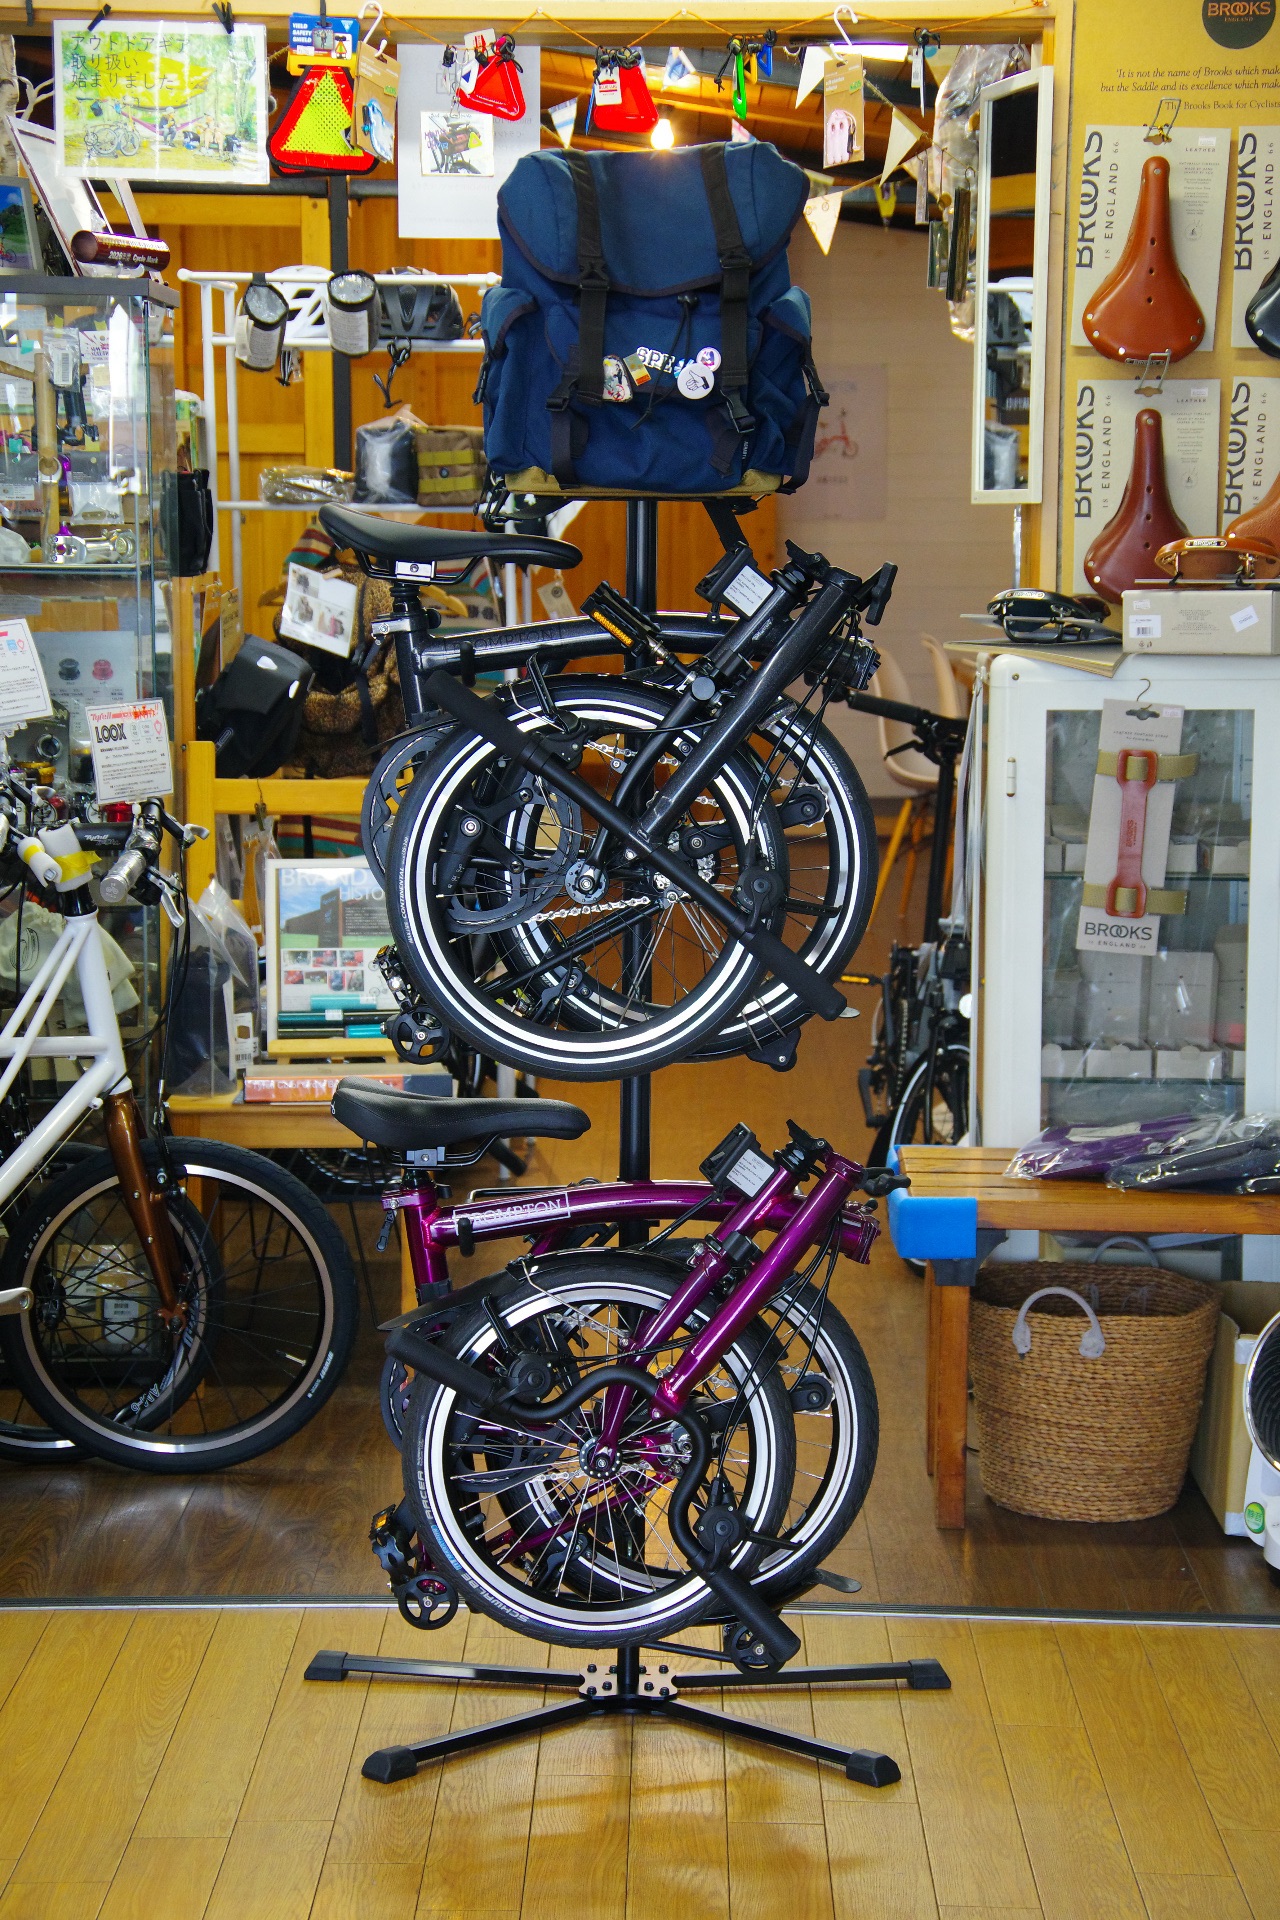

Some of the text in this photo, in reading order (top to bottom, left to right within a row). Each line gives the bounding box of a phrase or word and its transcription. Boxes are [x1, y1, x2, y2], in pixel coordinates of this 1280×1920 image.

[1207, 1, 1271, 16] BROOKS
[71, 35, 190, 53] アウトドアギア
[71, 53, 139, 71] 取り扱い
[1127, 69, 1134, 78] is
[1152, 68, 1165, 77] the
[1192, 67, 1202, 78] of
[1203, 66, 1233, 76] Brooks
[1235, 66, 1259, 76] which
[1261, 65, 1280, 75] mak
[71, 72, 175, 90] 始まりました
[1100, 79, 1280, 92] but the Saddle and its excellence which mak
[1165, 101, 1181, 110] Th
[1183, 101, 1211, 110] Brooks
[1213, 100, 1233, 109] Book
[1235, 99, 1248, 109] for
[1076, 131, 1103, 269] BROOKS
[1104, 163, 1119, 240] ENGLAND
[1234, 132, 1257, 270] BROOKS
[1262, 163, 1274, 240] ENGLAND
[132, 253, 147, 263] Cycle
[1074, 385, 1096, 518] BROOKS
[1102, 415, 1112, 489] ENGLAND
[1223, 381, 1251, 515] BROOKS
[1253, 412, 1267, 488] ENGLAND
[281, 868, 368, 886] BRAND
[340, 886, 385, 900] HISTO
[399, 867, 407, 919] CONTINENTAL
[1084, 921, 1153, 941] BROOKS
[1098, 940, 1136, 948] ENGLAND
[23, 1216, 52, 1260] KENDA
[417, 1470, 434, 1521] RACER
[461, 1572, 530, 1624] SCHWALBE
